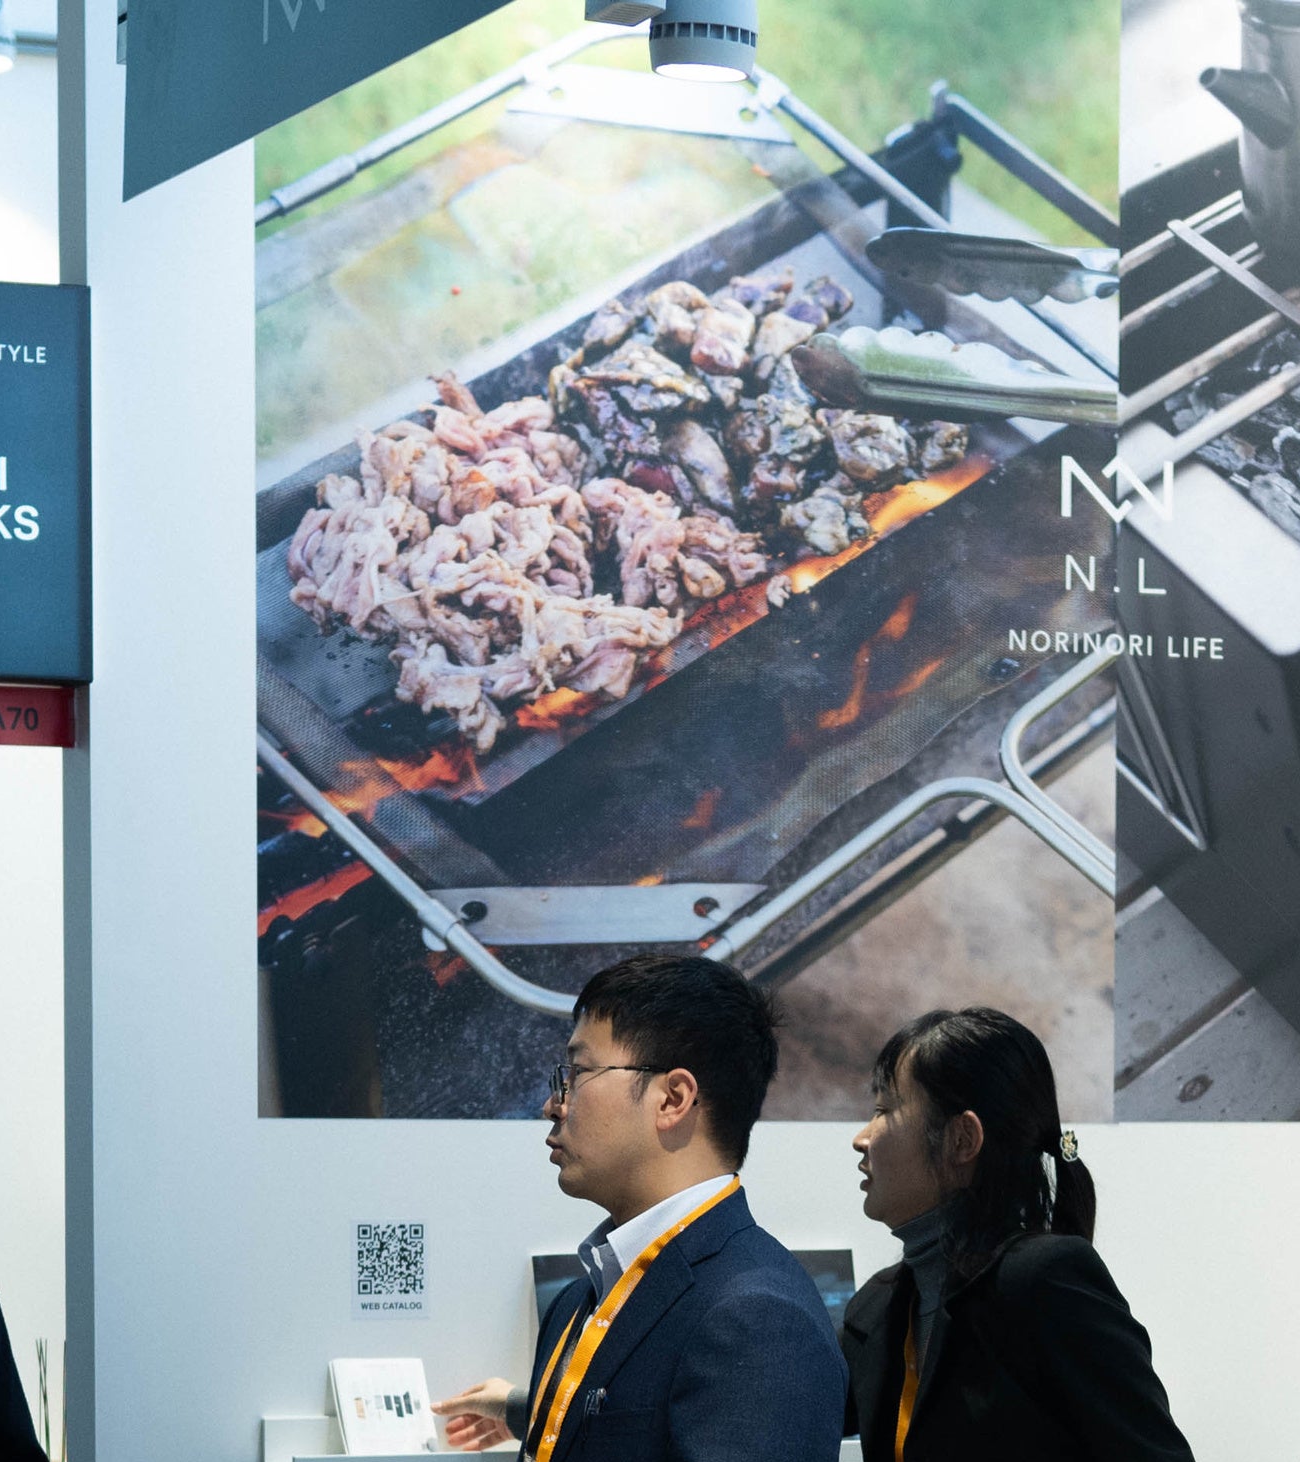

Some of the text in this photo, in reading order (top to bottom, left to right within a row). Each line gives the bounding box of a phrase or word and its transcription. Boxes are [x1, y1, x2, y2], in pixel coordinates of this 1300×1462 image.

[1008, 629, 1224, 660] NORINORI LIFE
[360, 1301, 422, 1310] WEB CATALOG
